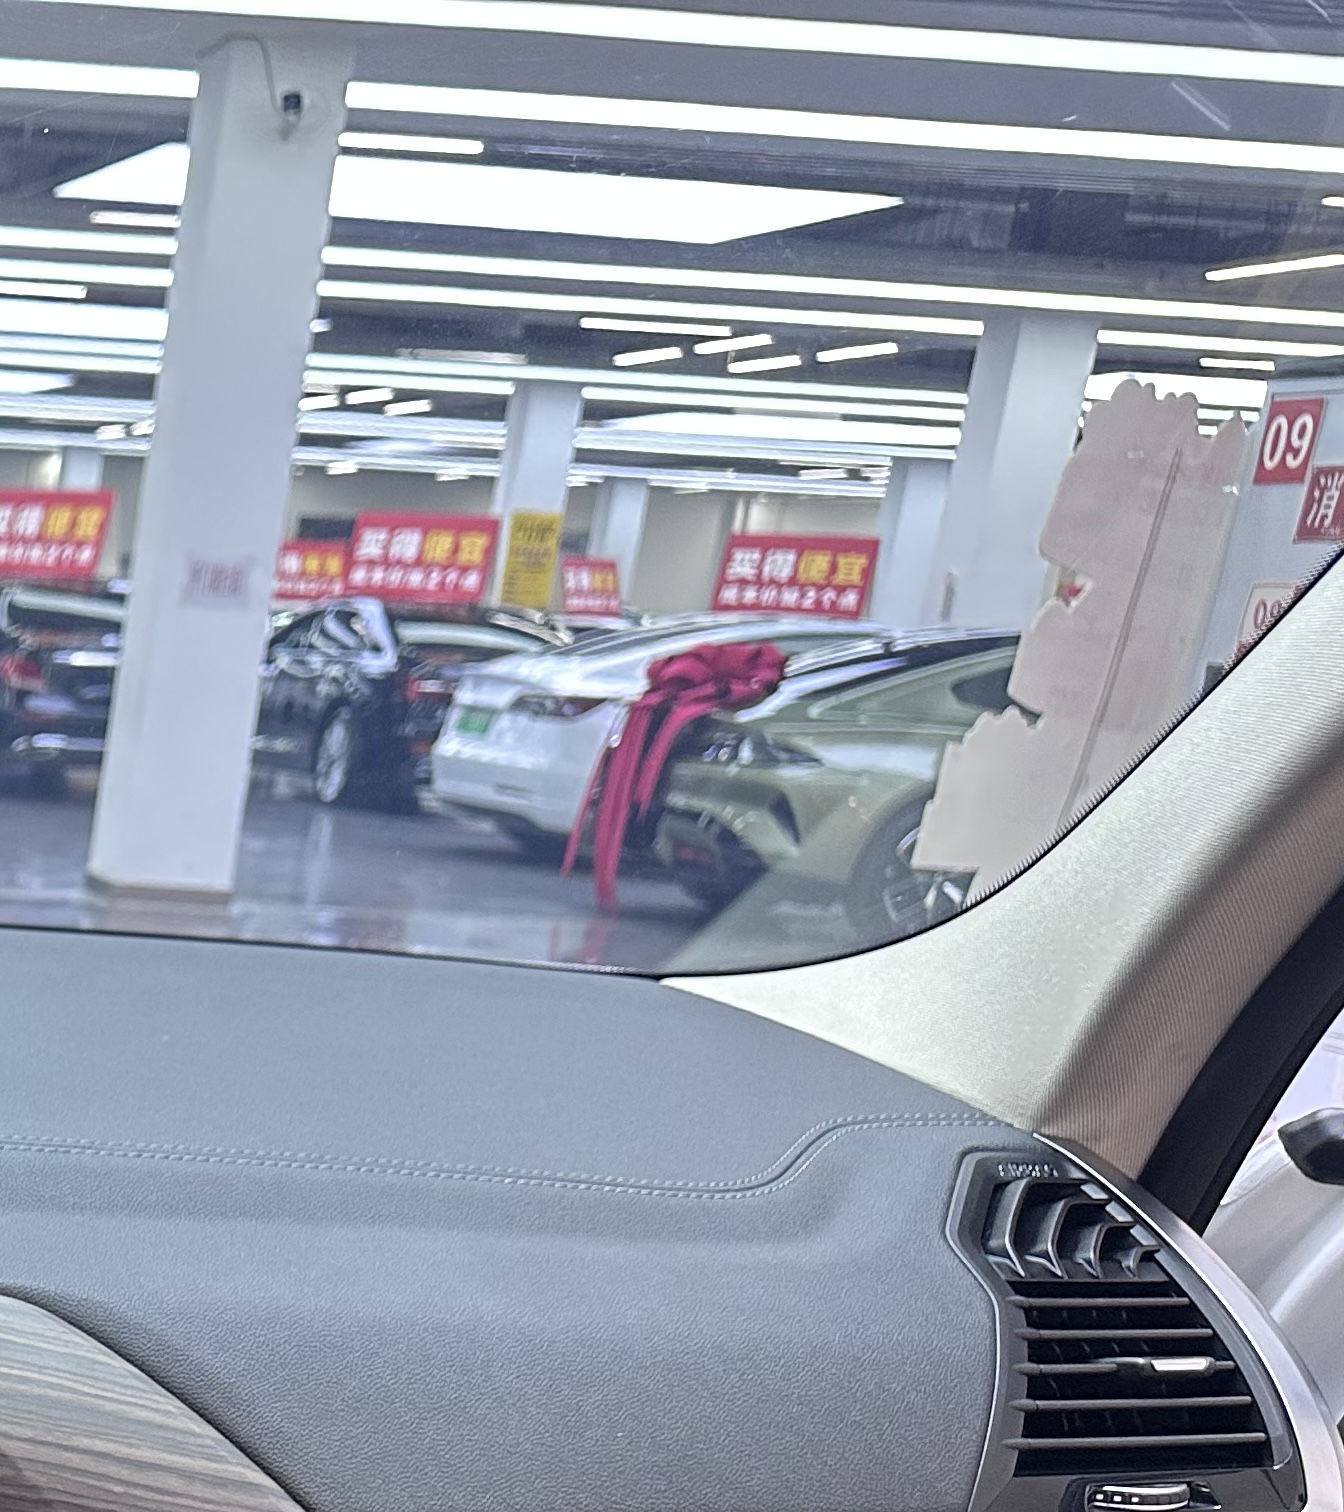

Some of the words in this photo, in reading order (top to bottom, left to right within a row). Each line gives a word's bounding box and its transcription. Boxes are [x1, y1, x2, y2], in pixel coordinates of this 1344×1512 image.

[1263, 415, 1313, 470] 09
[1307, 472, 1344, 528] 消
[354, 526, 491, 567] 买得便宜
[724, 547, 869, 586] 买得便宜
